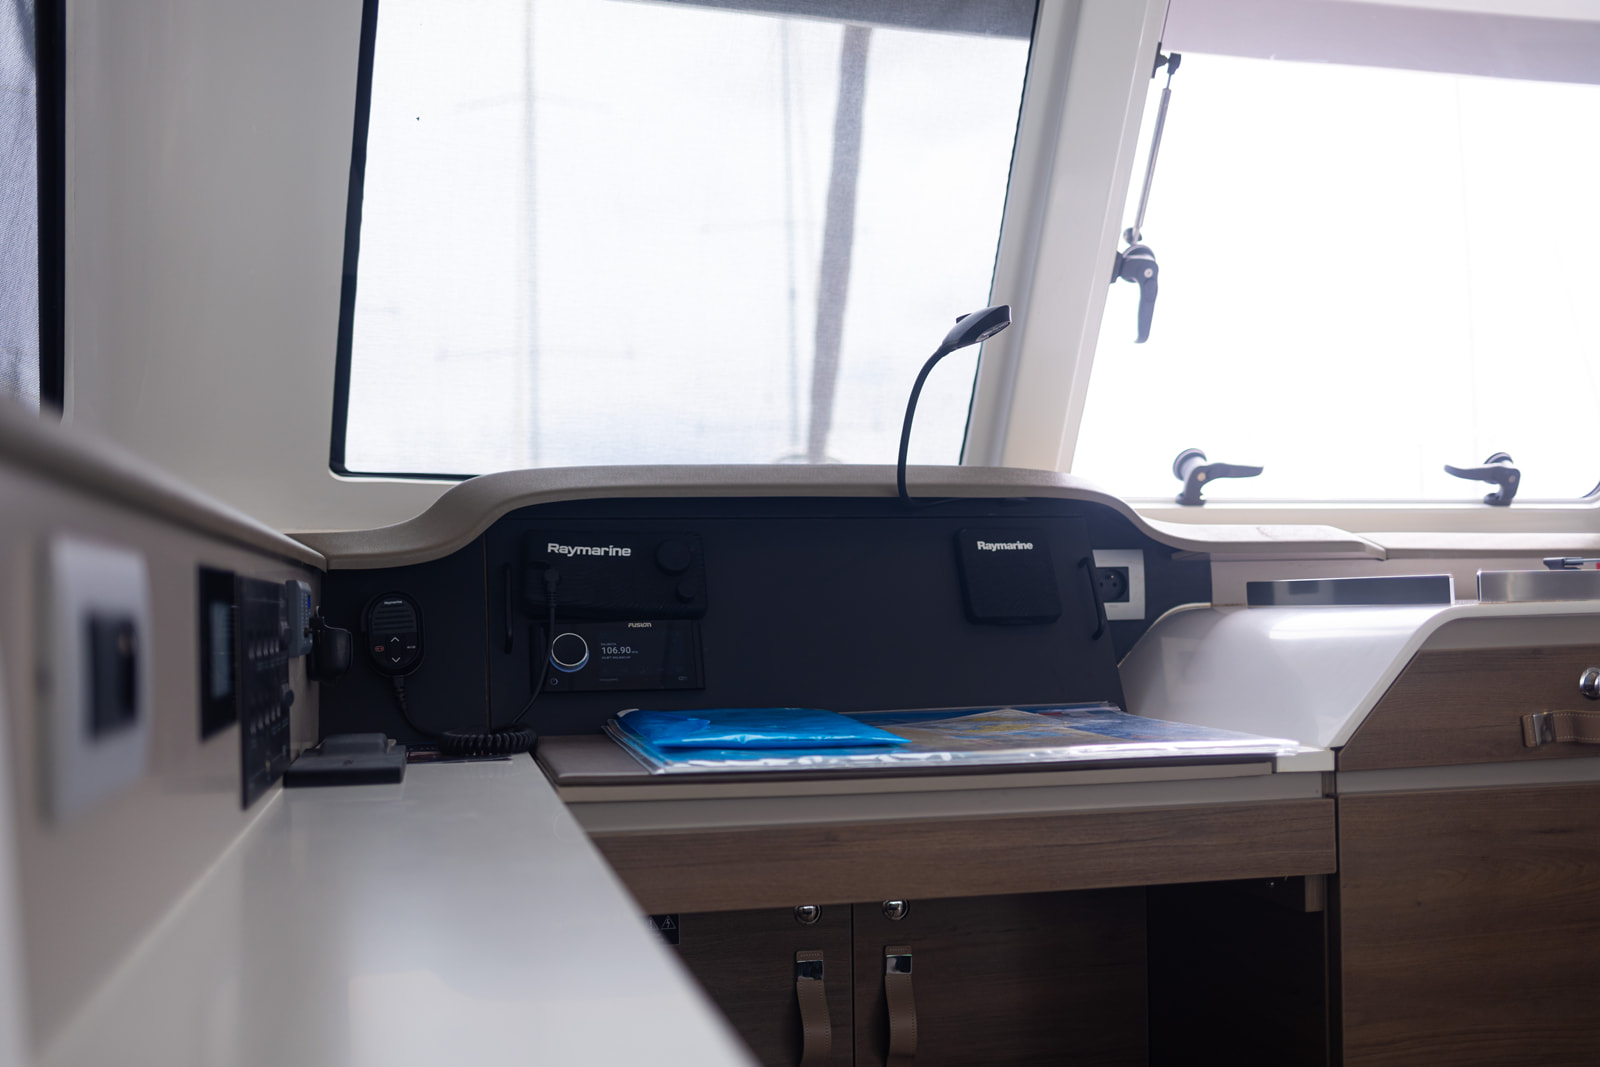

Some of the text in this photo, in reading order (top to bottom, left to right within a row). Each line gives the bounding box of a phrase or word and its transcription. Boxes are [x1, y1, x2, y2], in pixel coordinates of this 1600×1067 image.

[547, 542, 631, 557] Raymarine
[976, 540, 1034, 552] Raymarine
[601, 646, 631, 655] 106.90
